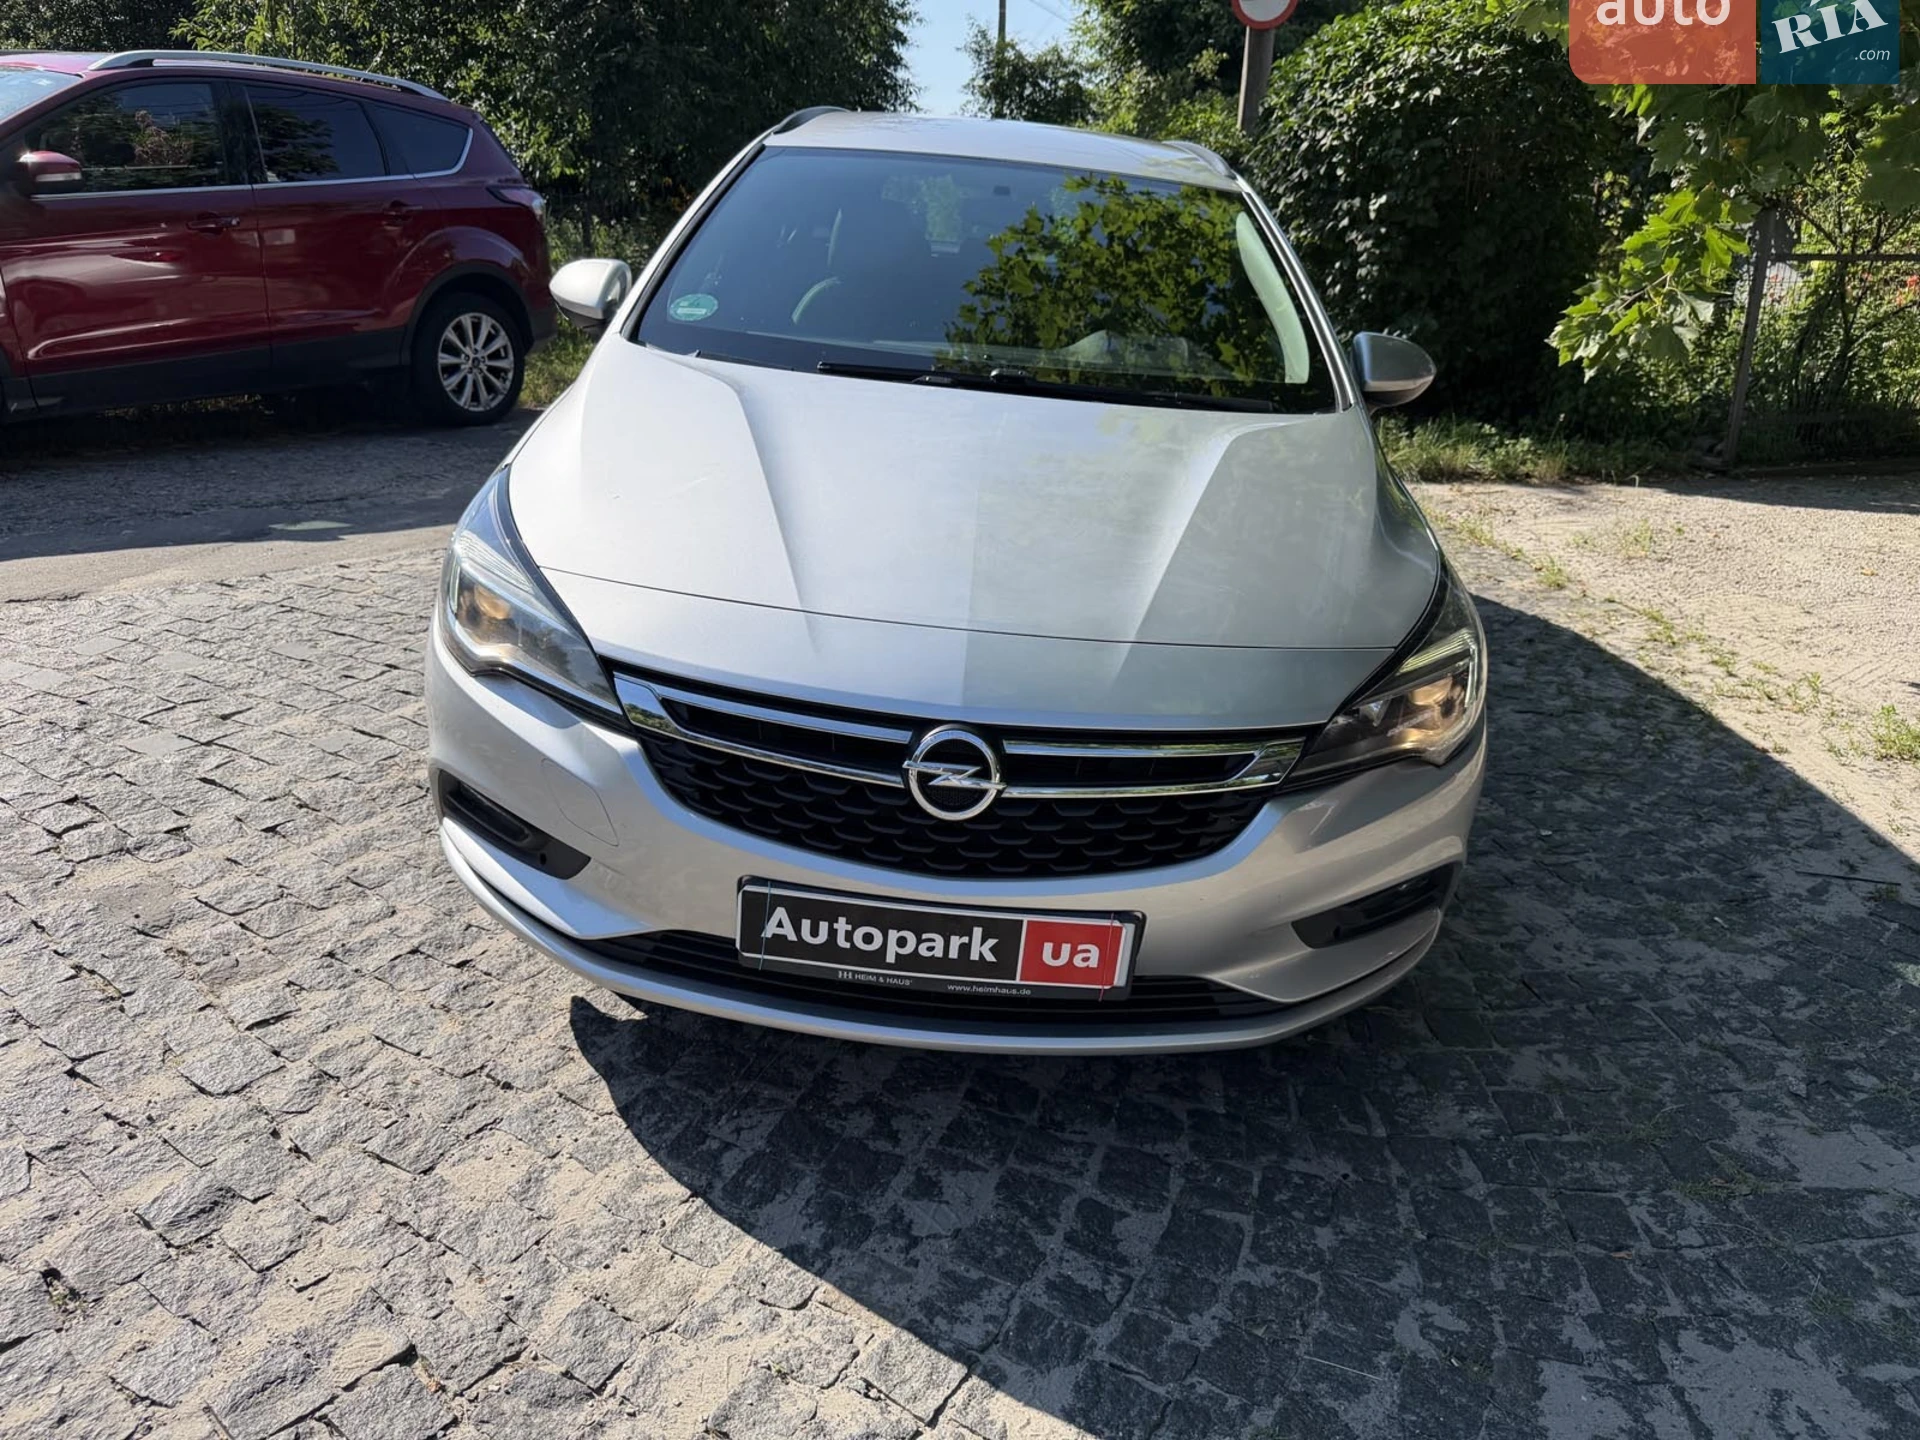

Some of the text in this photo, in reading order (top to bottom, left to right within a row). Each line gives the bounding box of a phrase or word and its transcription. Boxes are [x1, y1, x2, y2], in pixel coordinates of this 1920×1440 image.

[761, 906, 1100, 969] Autopark ua
[854, 973, 877, 982] HEIM
[878, 975, 884, 983] &
[947, 984, 1032, 996] www.heimhaus.de
